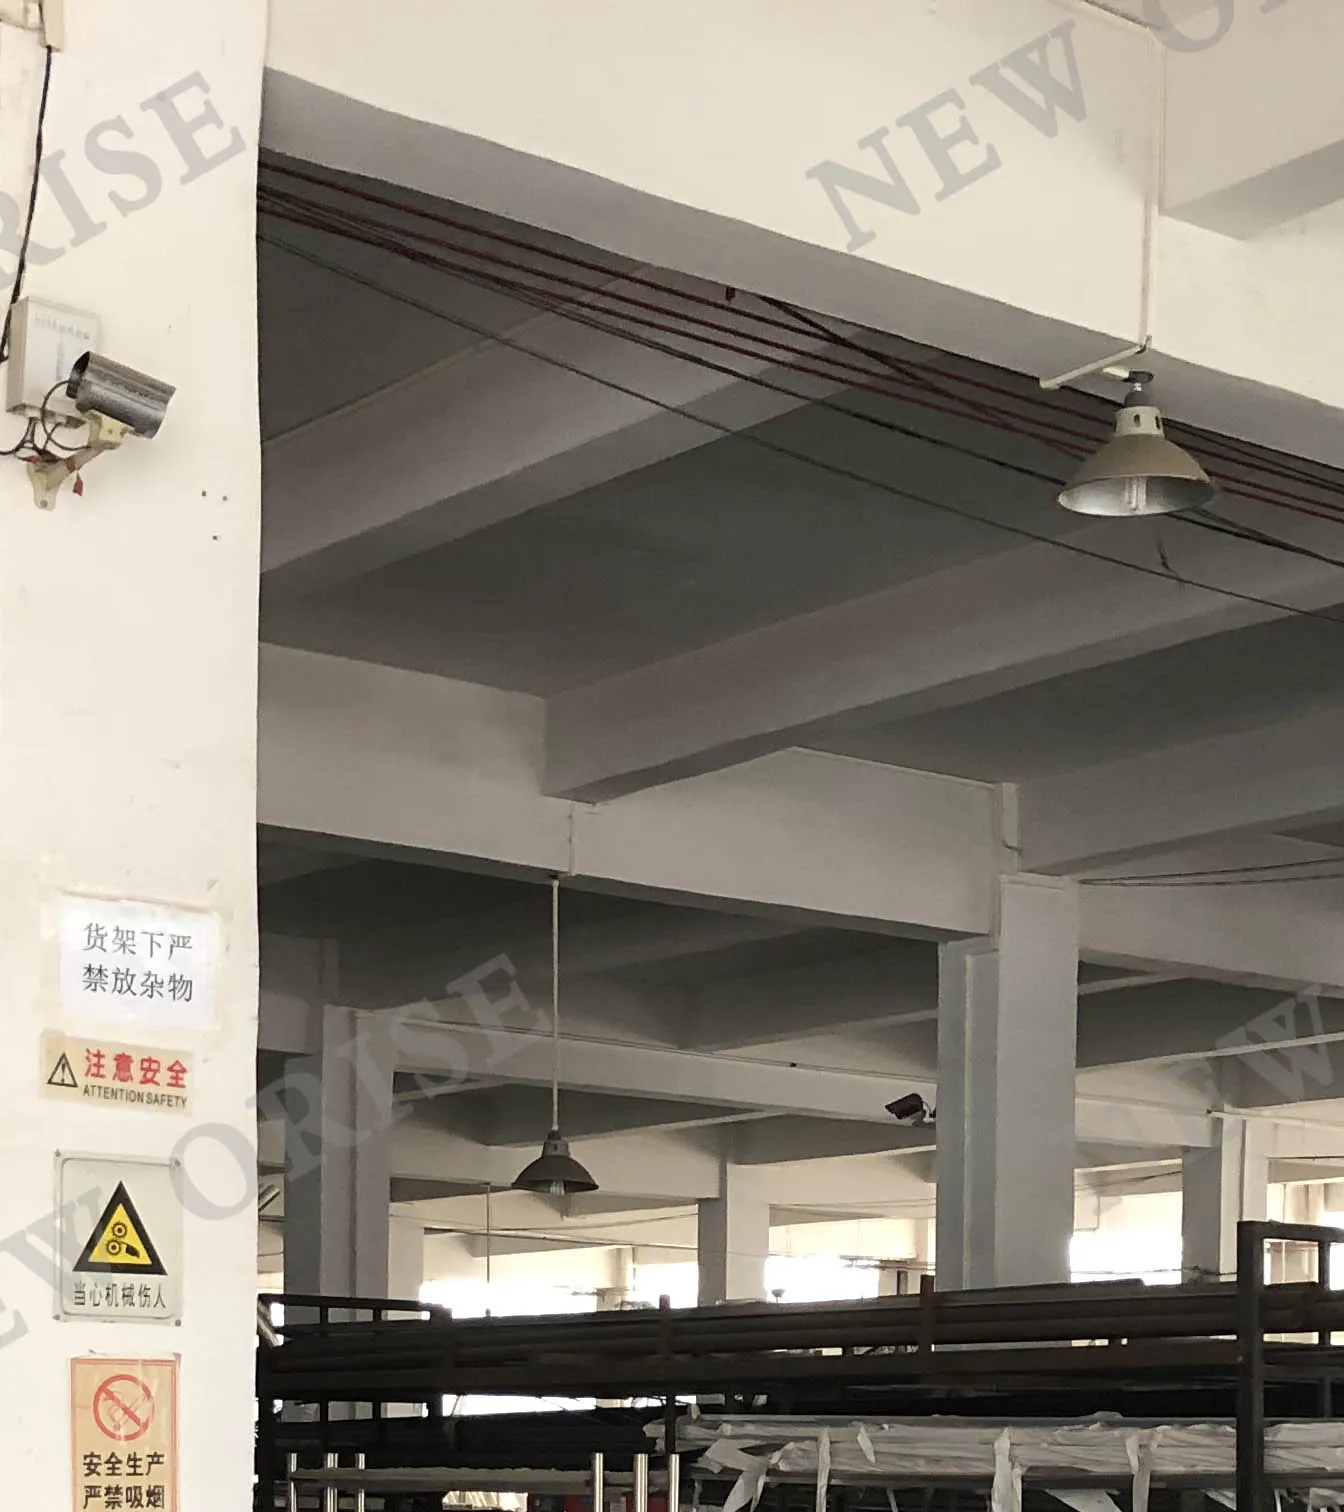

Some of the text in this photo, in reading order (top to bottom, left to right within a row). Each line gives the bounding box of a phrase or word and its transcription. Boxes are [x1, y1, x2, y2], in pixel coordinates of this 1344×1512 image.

[82, 923, 193, 960] 货架下严
[82, 963, 193, 1002] 禁放杂物
[84, 1048, 188, 1088] 注意安全
[73, 1282, 167, 1309] 当心机械伤人
[82, 1451, 165, 1478] 安全生产
[82, 1484, 165, 1510] 严禁吸烟
